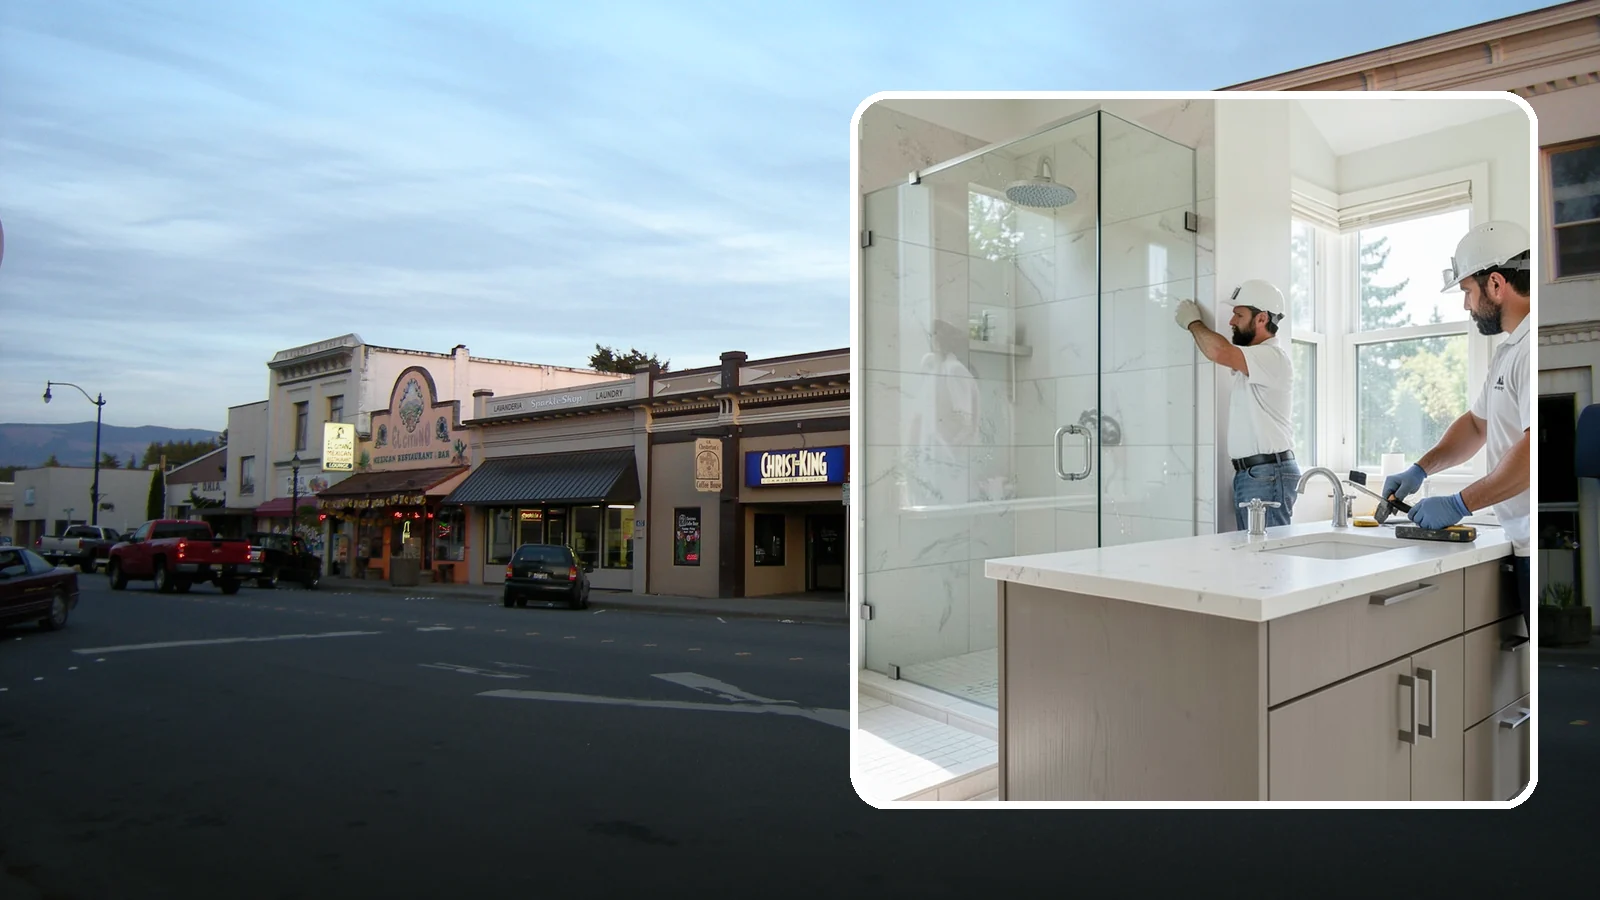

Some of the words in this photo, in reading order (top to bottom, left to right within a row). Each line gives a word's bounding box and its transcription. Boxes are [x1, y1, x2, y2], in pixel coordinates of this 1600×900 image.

[595, 389, 623, 400] LAUNDRY
[494, 402, 523, 412] LAVANDERIA
[530, 397, 560, 409] Sparkle
[562, 395, 582, 407] Shop
[374, 455, 396, 464] MEXICAN
[397, 451, 433, 462] RESTAURANT
[438, 450, 450, 459] BAR
[761, 452, 797, 478] CHRIST
[799, 450, 827, 476] KING
[696, 480, 709, 489] Coffee
